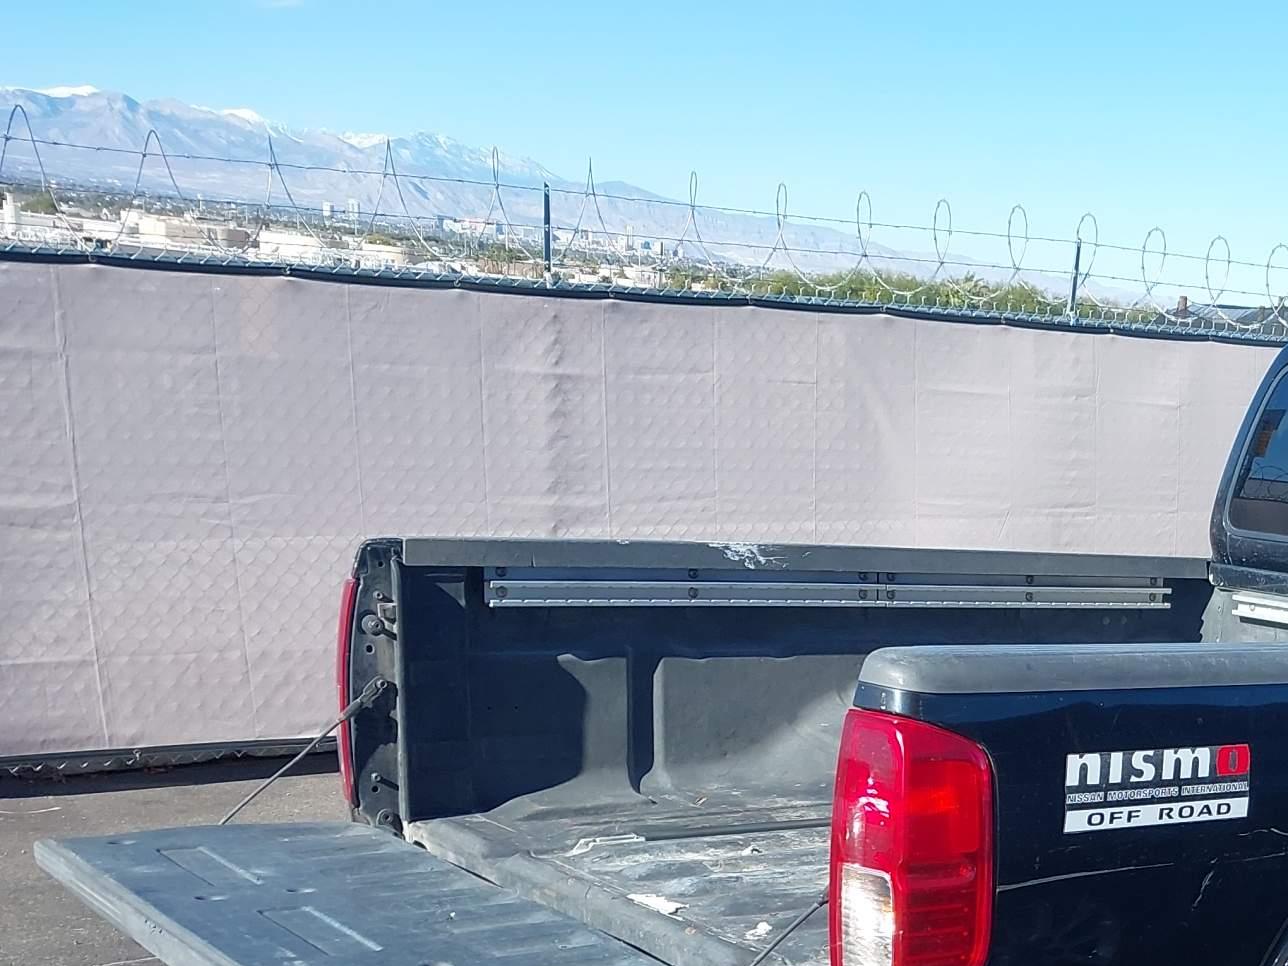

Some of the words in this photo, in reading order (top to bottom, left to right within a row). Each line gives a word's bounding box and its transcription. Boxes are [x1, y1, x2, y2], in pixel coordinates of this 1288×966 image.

[1066, 744, 1250, 786] nismo
[1066, 791, 1104, 803] NISSAN
[1107, 787, 1179, 801] MOTORSPORTS
[1181, 782, 1249, 796] INTERNATIONAL
[1087, 810, 1141, 826] OFF
[1158, 803, 1232, 820] ROAD
